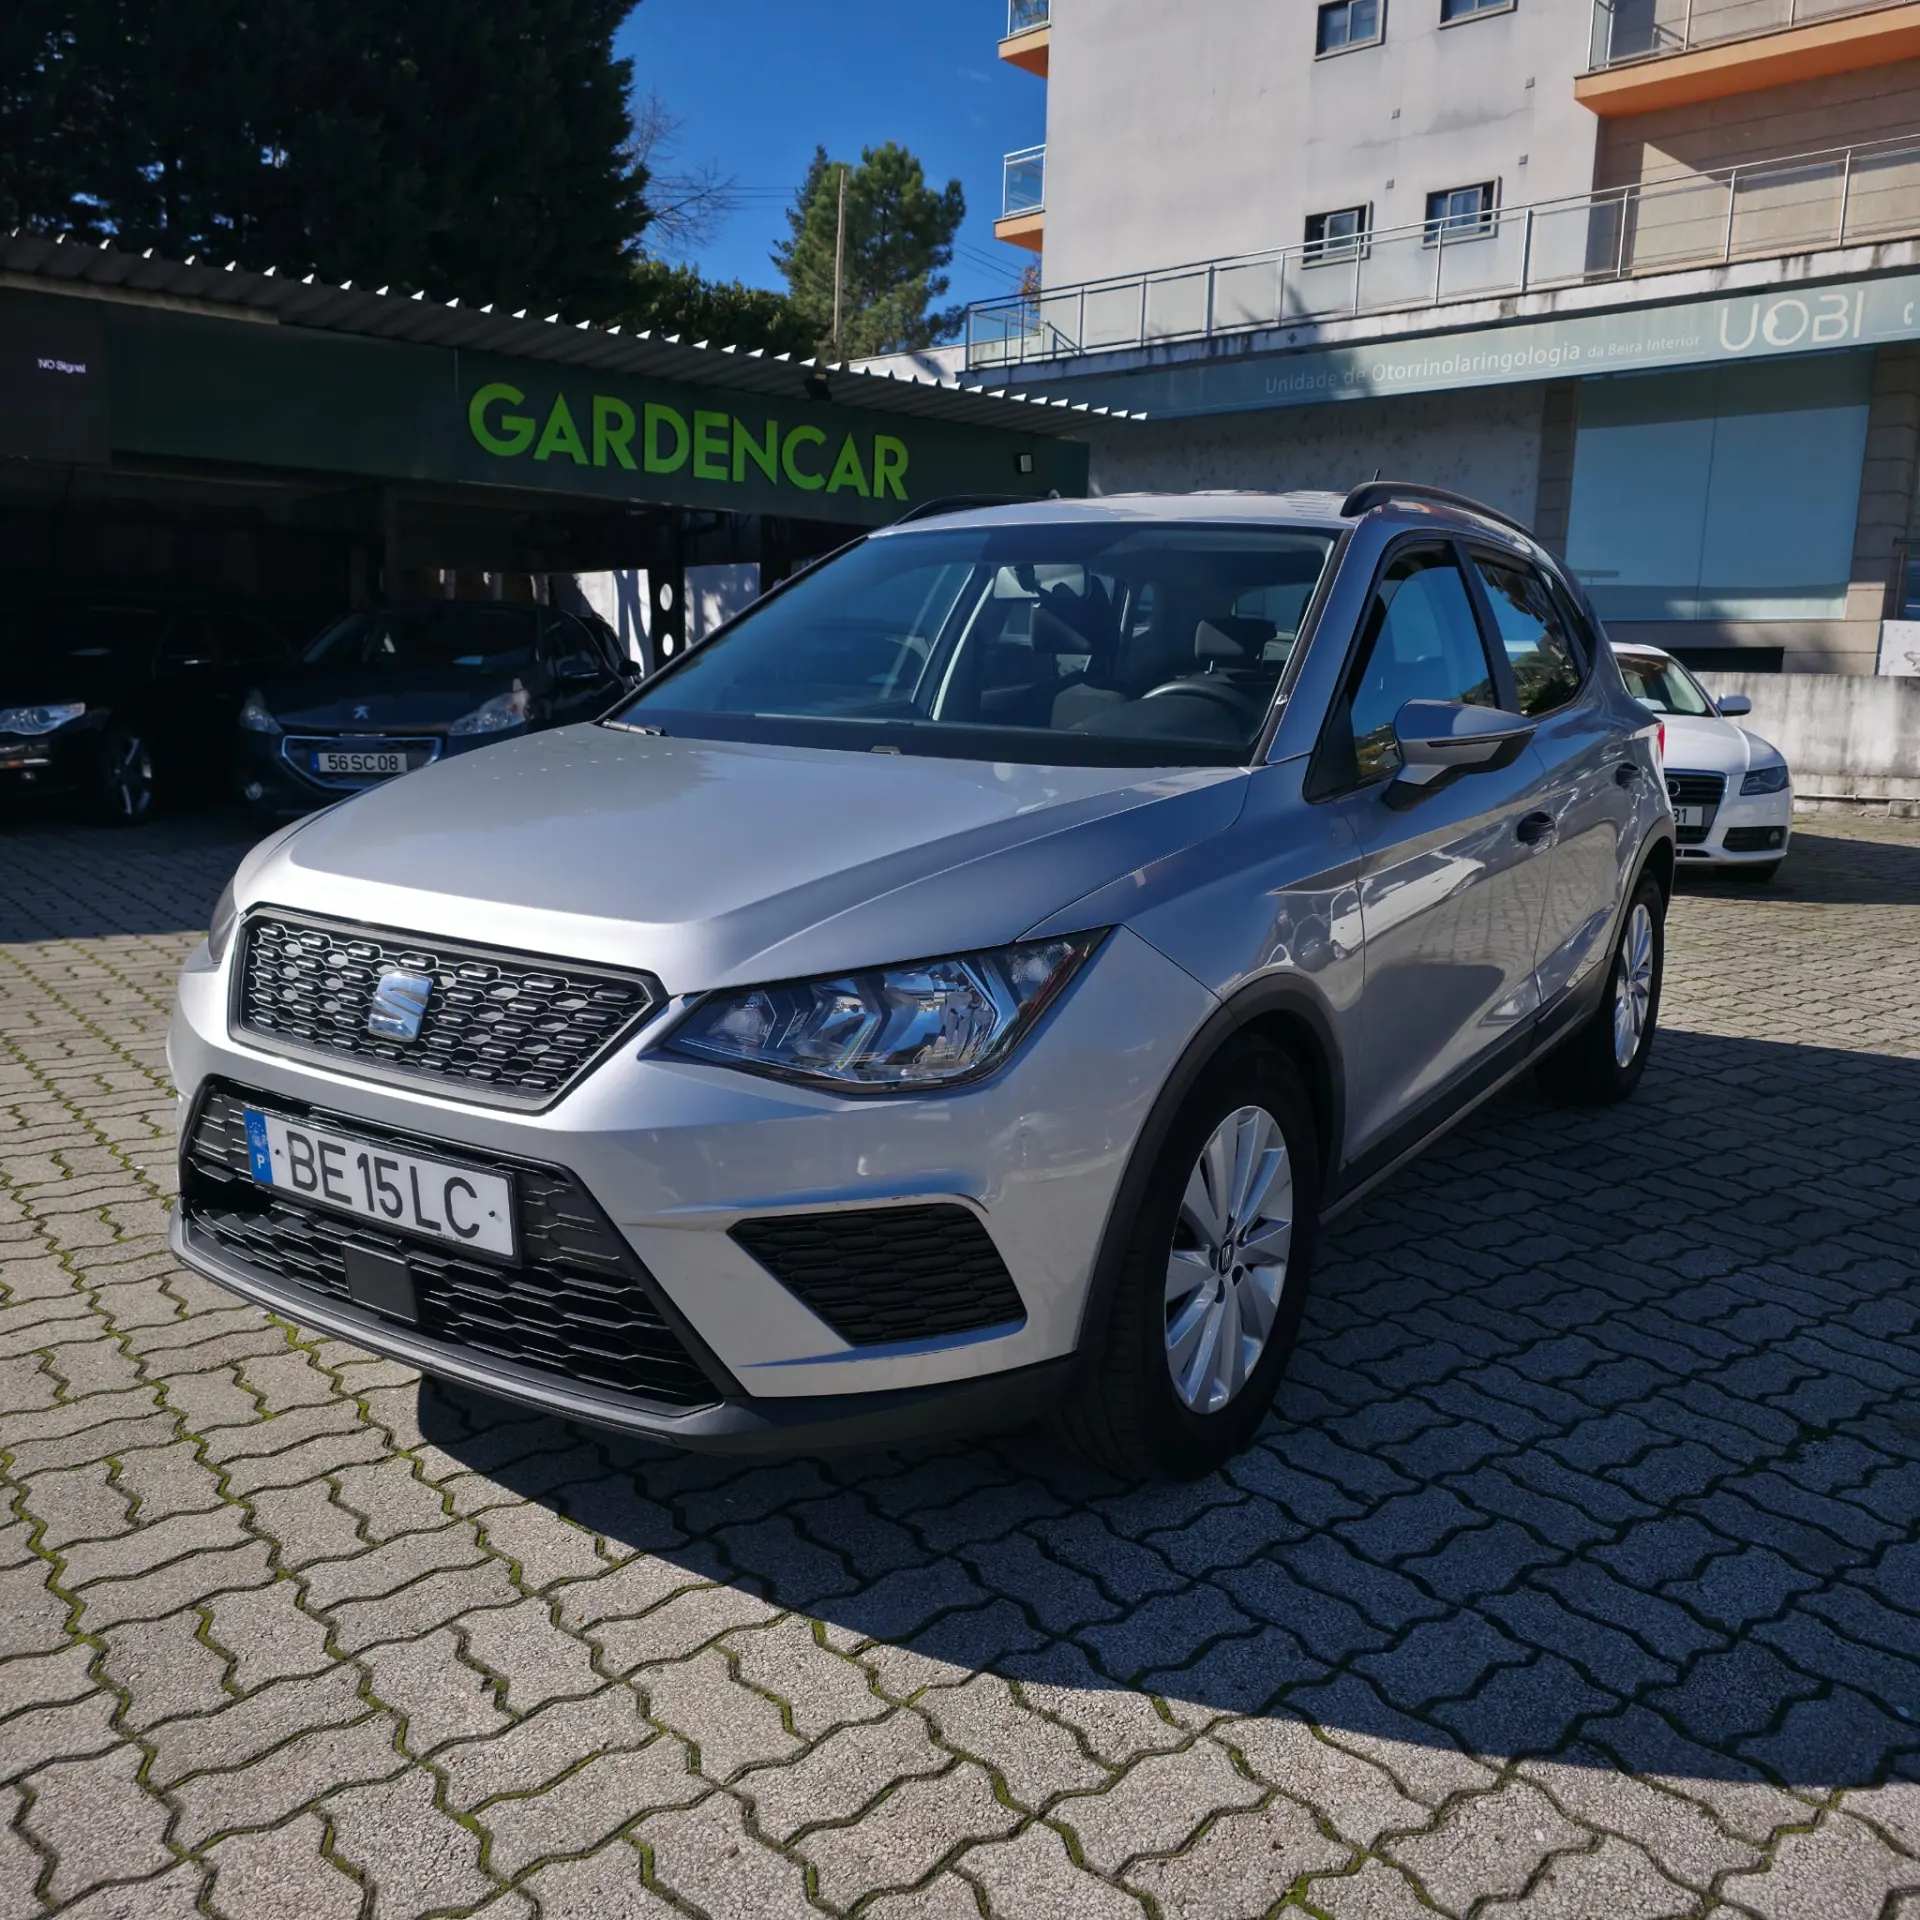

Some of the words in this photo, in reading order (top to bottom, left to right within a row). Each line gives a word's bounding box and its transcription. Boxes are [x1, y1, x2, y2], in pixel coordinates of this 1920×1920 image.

[1265, 370, 1338, 394] Unidade
[1344, 367, 1366, 386] de
[1371, 342, 1581, 382] Otorrinolaringologia
[1588, 344, 1604, 358] da
[1608, 340, 1643, 357] Beira
[1647, 333, 1701, 351] Interior
[468, 382, 910, 501] GARDENCAR
[285, 1129, 481, 1239] BE15LC
